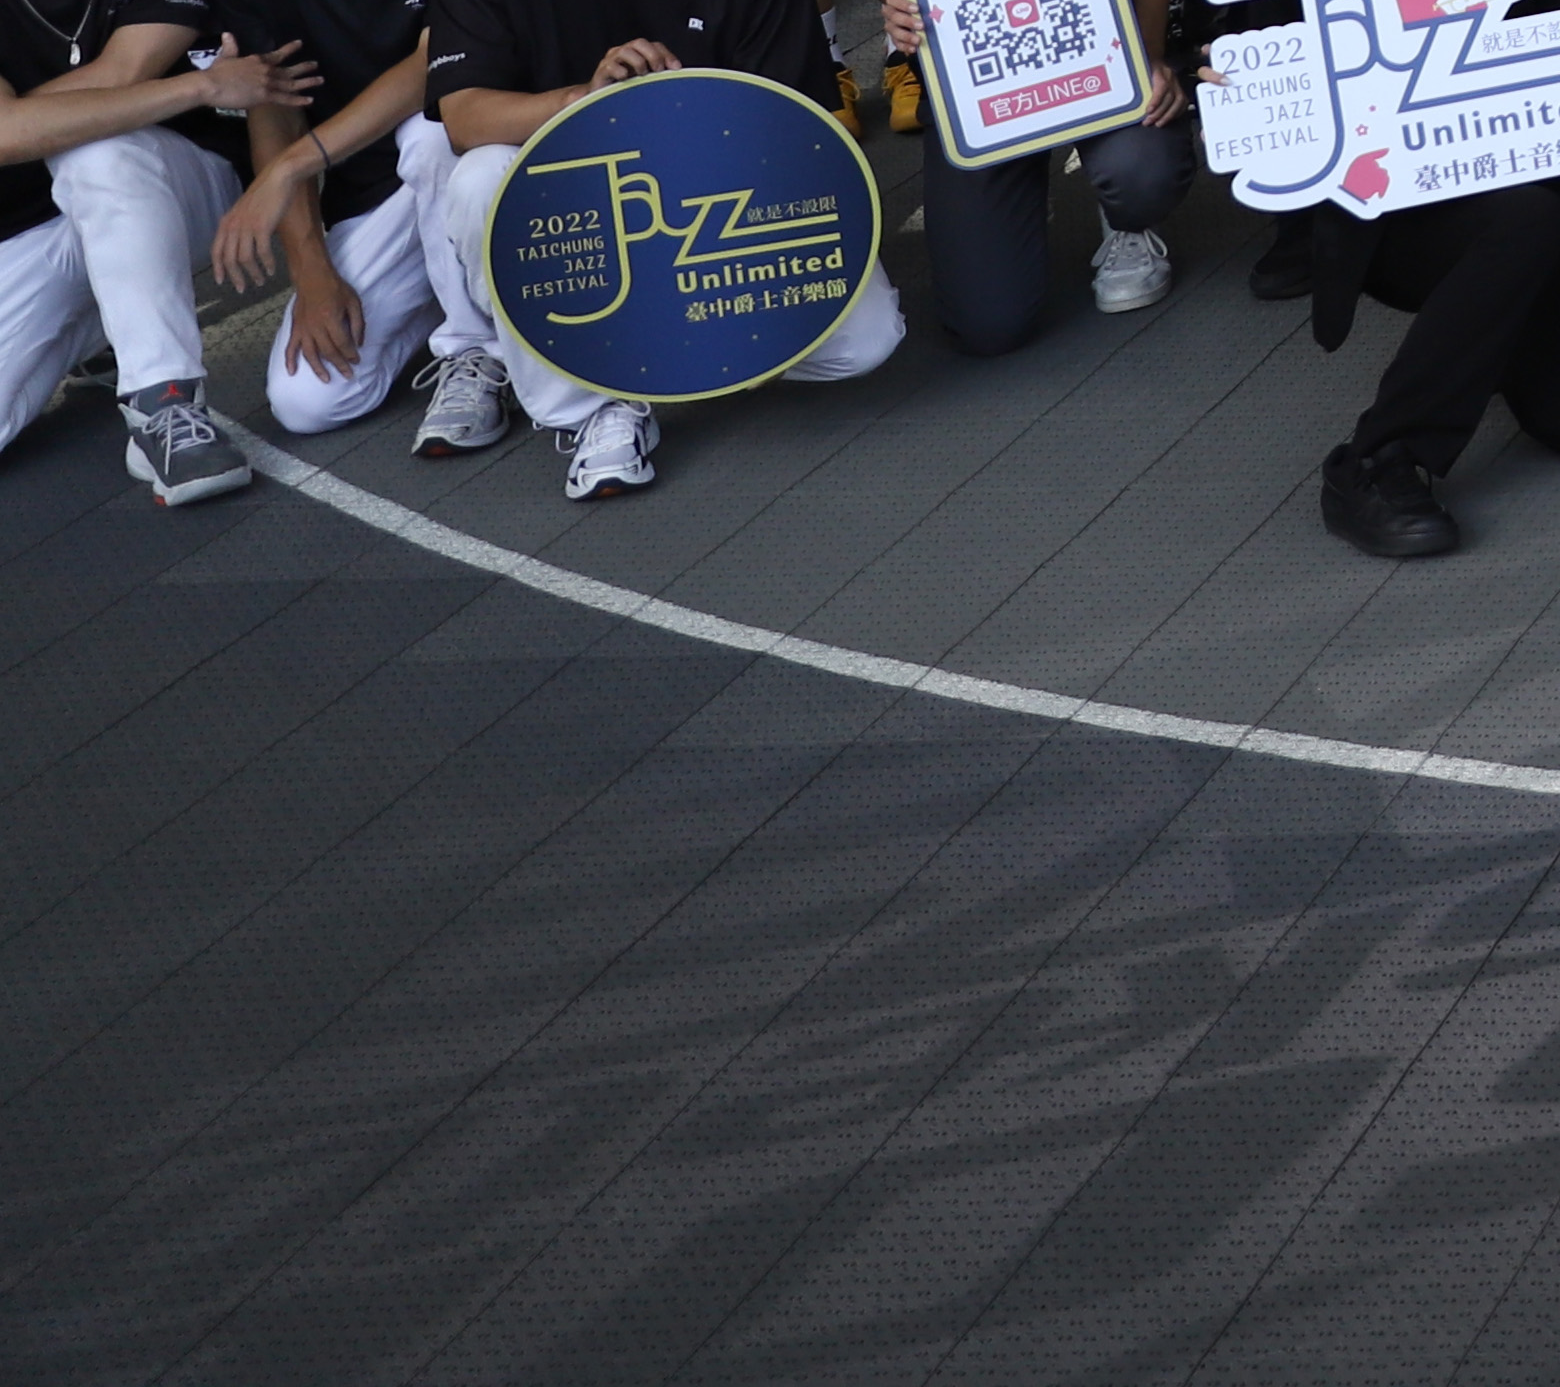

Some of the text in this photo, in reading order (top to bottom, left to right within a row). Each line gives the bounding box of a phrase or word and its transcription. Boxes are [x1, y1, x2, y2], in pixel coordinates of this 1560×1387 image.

[1220, 36, 1307, 76] 2022
[989, 74, 1103, 119] 官方LINE@
[1205, 74, 1313, 111] TAICHUNG
[1264, 98, 1316, 125] JAZZ
[1213, 127, 1320, 161] FESTIVAL
[527, 210, 602, 241] 2022
[746, 194, 839, 225] 就是不設限
[516, 235, 606, 263] TAICHUNG
[563, 253, 608, 276] JAZZ
[520, 274, 610, 300] FESTIVAL
[676, 248, 845, 295] Unlimited
[685, 276, 850, 323] 臺中爵士音樂節
